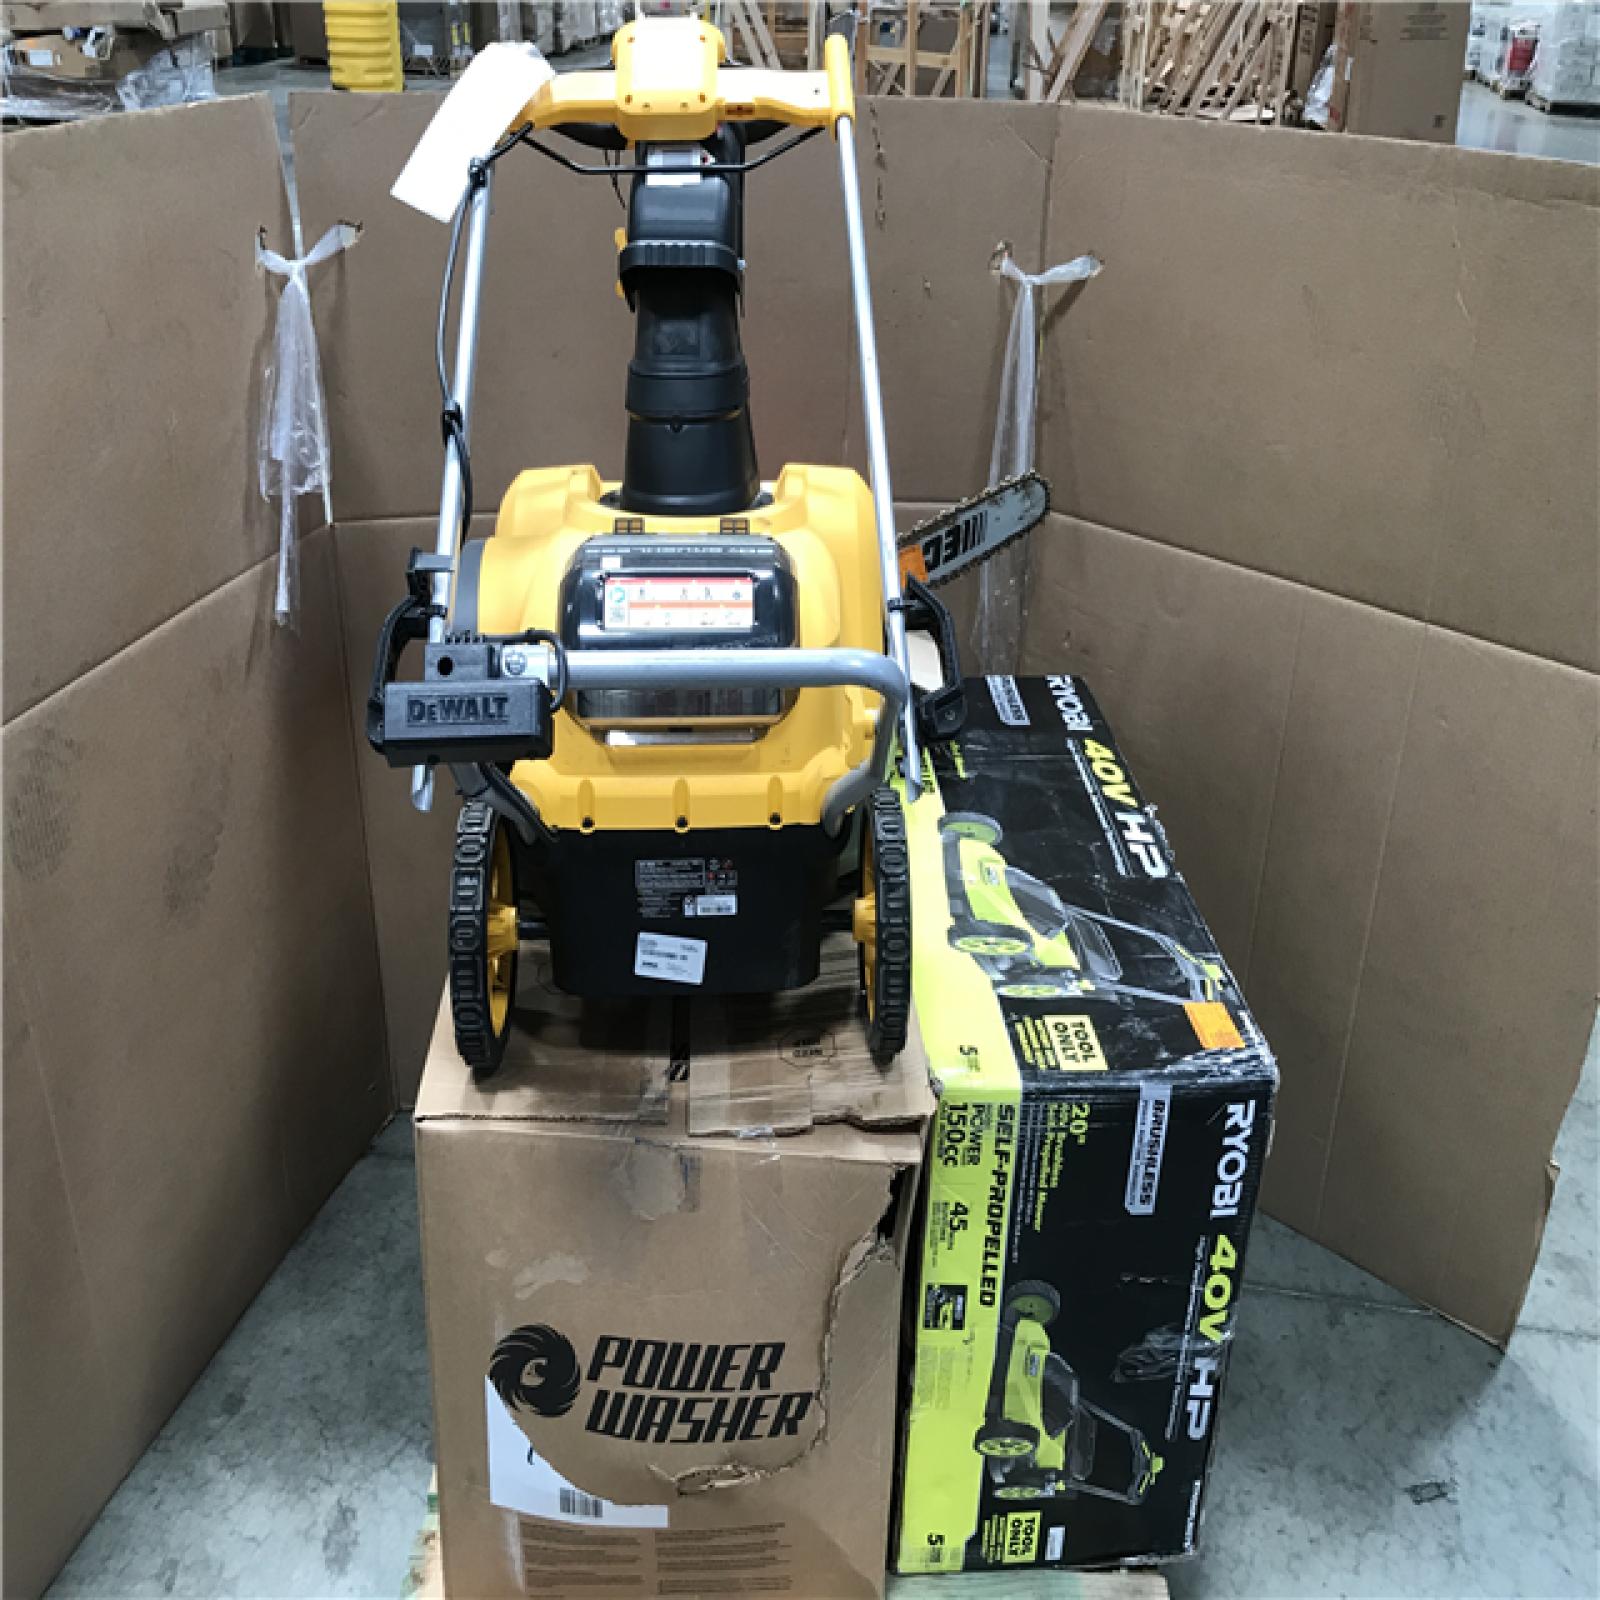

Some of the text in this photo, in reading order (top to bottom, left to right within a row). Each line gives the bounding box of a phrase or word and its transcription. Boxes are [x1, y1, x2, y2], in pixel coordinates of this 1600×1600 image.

[407, 695, 508, 724] DEWALT
[1046, 674, 1093, 731] RYOBI
[1084, 738, 1138, 808] 40V
[1115, 810, 1169, 879] HP
[1053, 1022, 1080, 1062] ONLY
[1071, 1021, 1097, 1063] TOOL
[1209, 1099, 1256, 1220] RYOBI
[949, 1201, 969, 1232] 45
[979, 1103, 1016, 1307] SELF-PROPELLED
[1199, 1234, 1238, 1344] 40V
[585, 1334, 786, 1391] POWER
[584, 1390, 813, 1443] WASHER
[1186, 1356, 1217, 1440] HP
